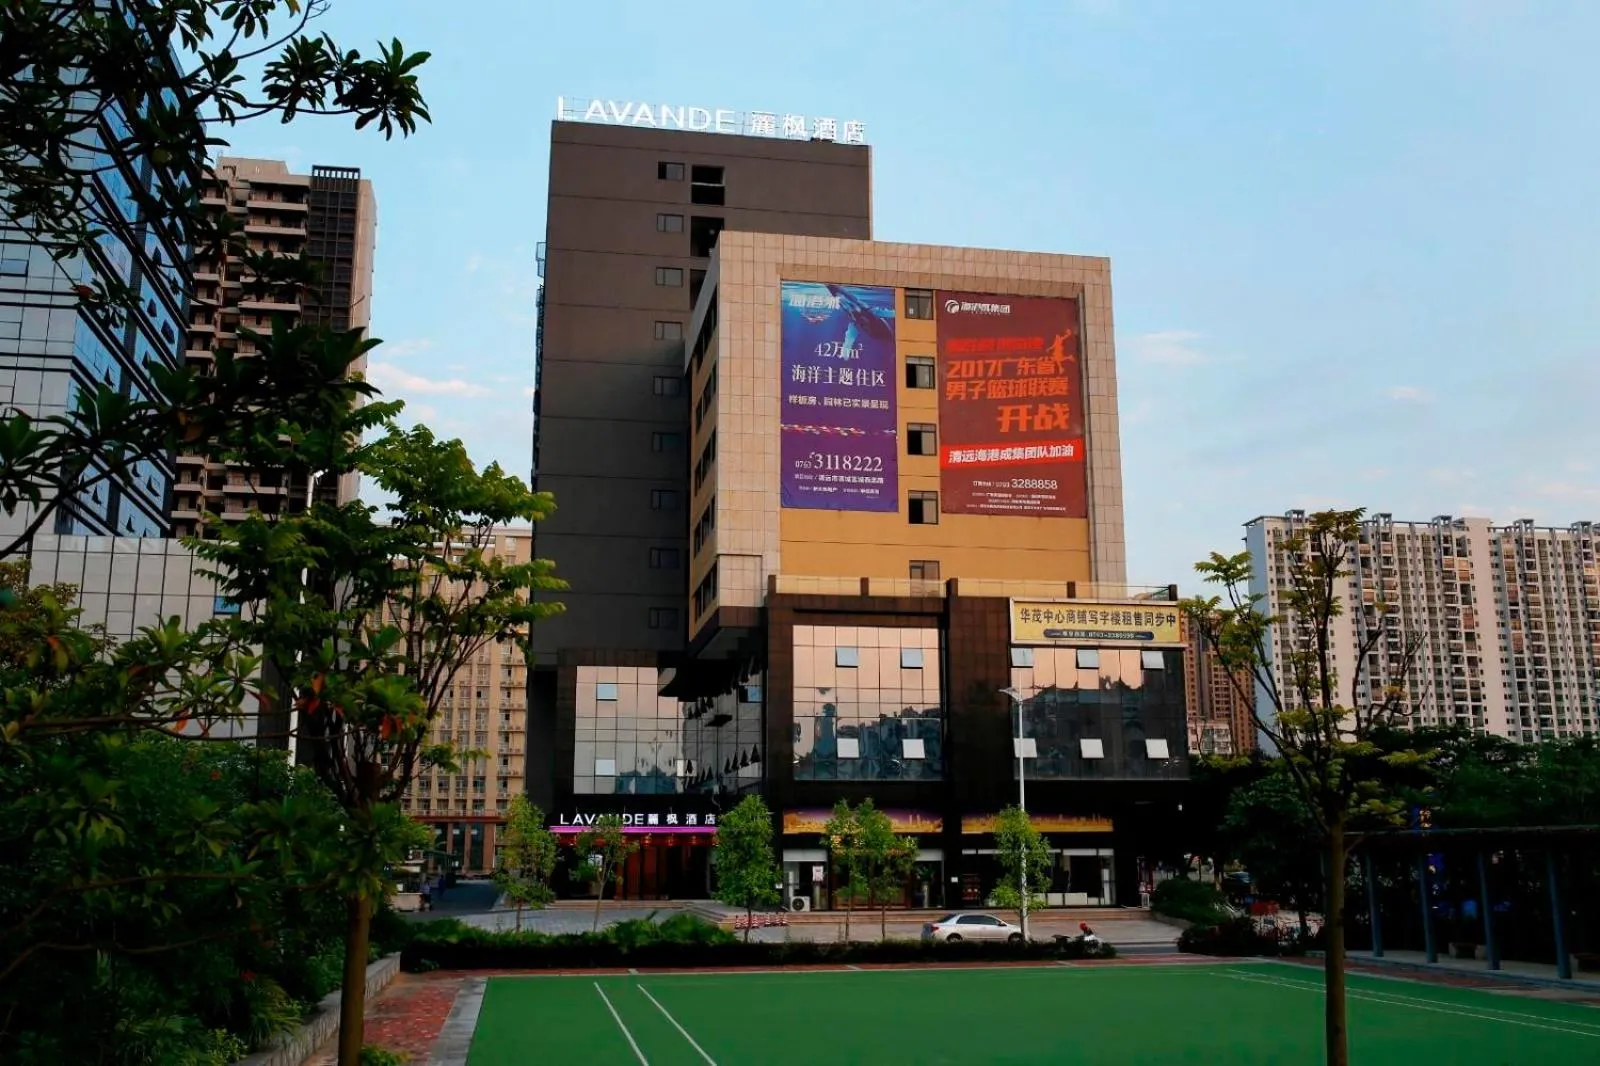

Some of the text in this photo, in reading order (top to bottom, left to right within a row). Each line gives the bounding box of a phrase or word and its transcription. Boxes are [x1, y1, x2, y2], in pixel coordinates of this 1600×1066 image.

[557, 96, 736, 133] LAVANDE
[791, 364, 886, 387] 海洋主题住区
[946, 377, 1068, 400] 男子篮球联赛
[997, 403, 1070, 432] 开战
[814, 454, 883, 472] 3118222
[1011, 478, 1058, 490] 3288858
[1020, 607, 1177, 628] 华茂中心商铺写字楼租售同步中
